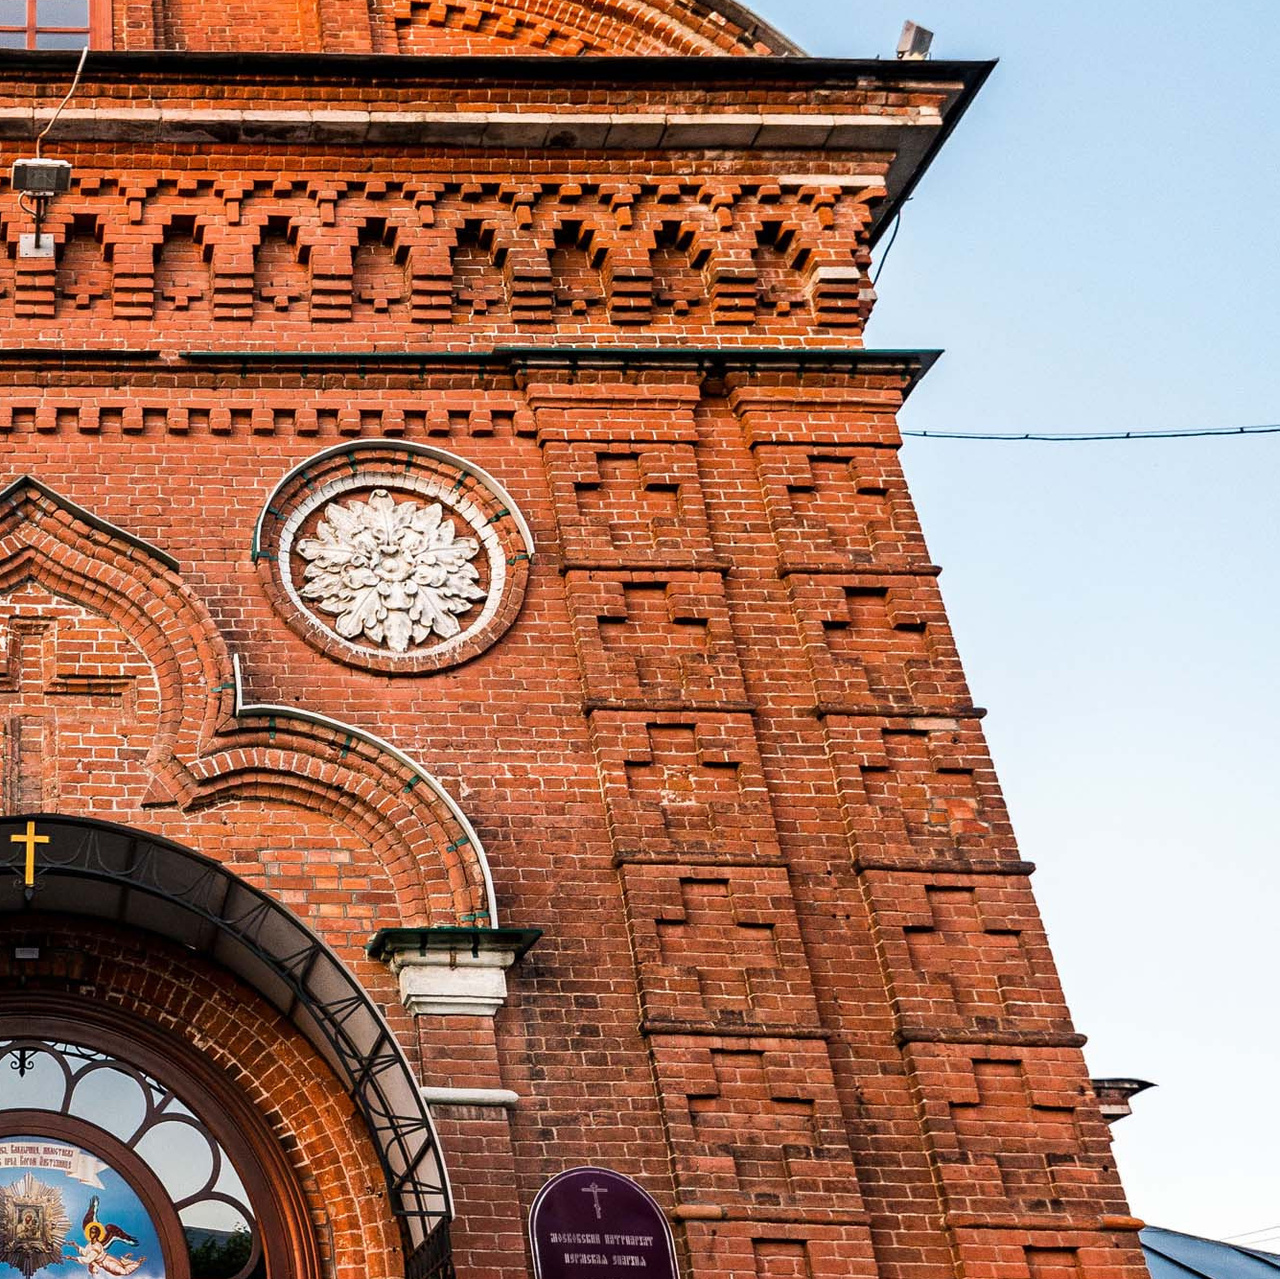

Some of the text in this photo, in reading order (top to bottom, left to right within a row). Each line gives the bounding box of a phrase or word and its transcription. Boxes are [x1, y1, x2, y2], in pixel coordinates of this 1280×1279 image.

[550, 1233, 654, 1247] МОСКОВСКИЙ ПАТРИАРХАТ
[564, 1253, 647, 1267] ПЕРМСКАЯ ЕПАРХИЯ
